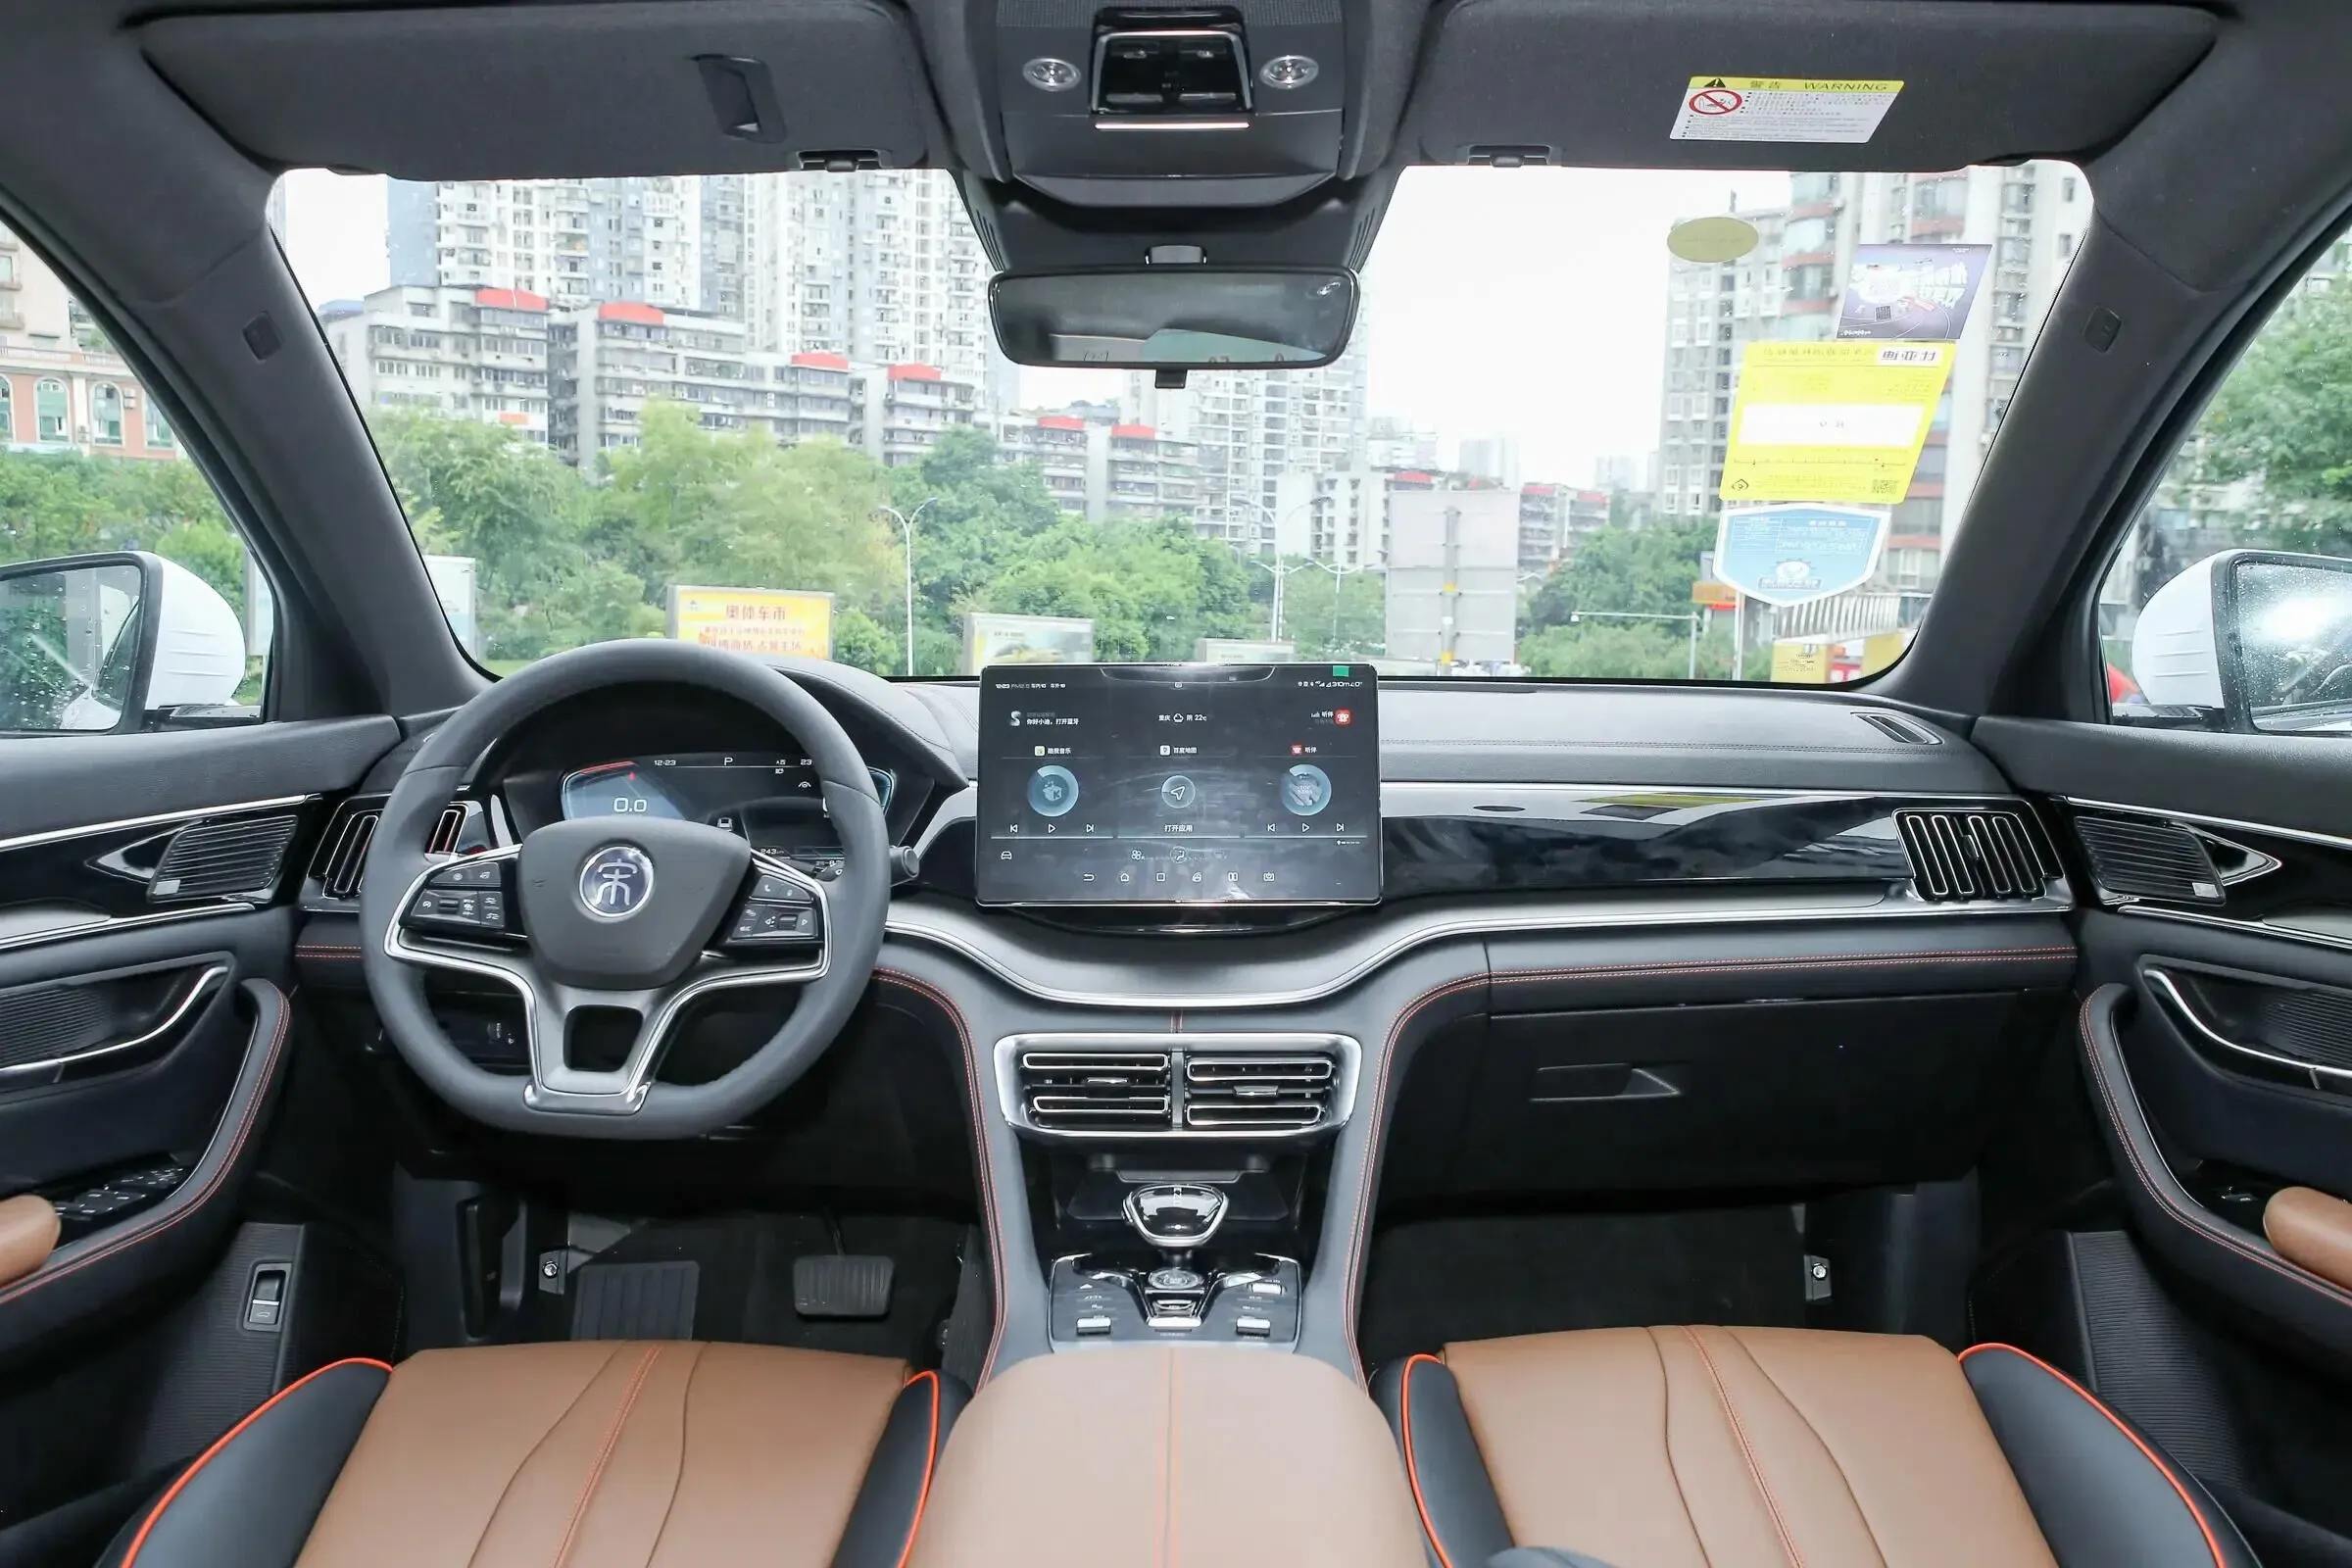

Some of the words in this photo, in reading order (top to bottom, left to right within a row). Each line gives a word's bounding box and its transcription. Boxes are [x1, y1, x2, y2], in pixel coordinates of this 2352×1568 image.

[1803, 81, 1887, 91] WARNING
[723, 757, 733, 766] P
[613, 797, 648, 812] 0.0
